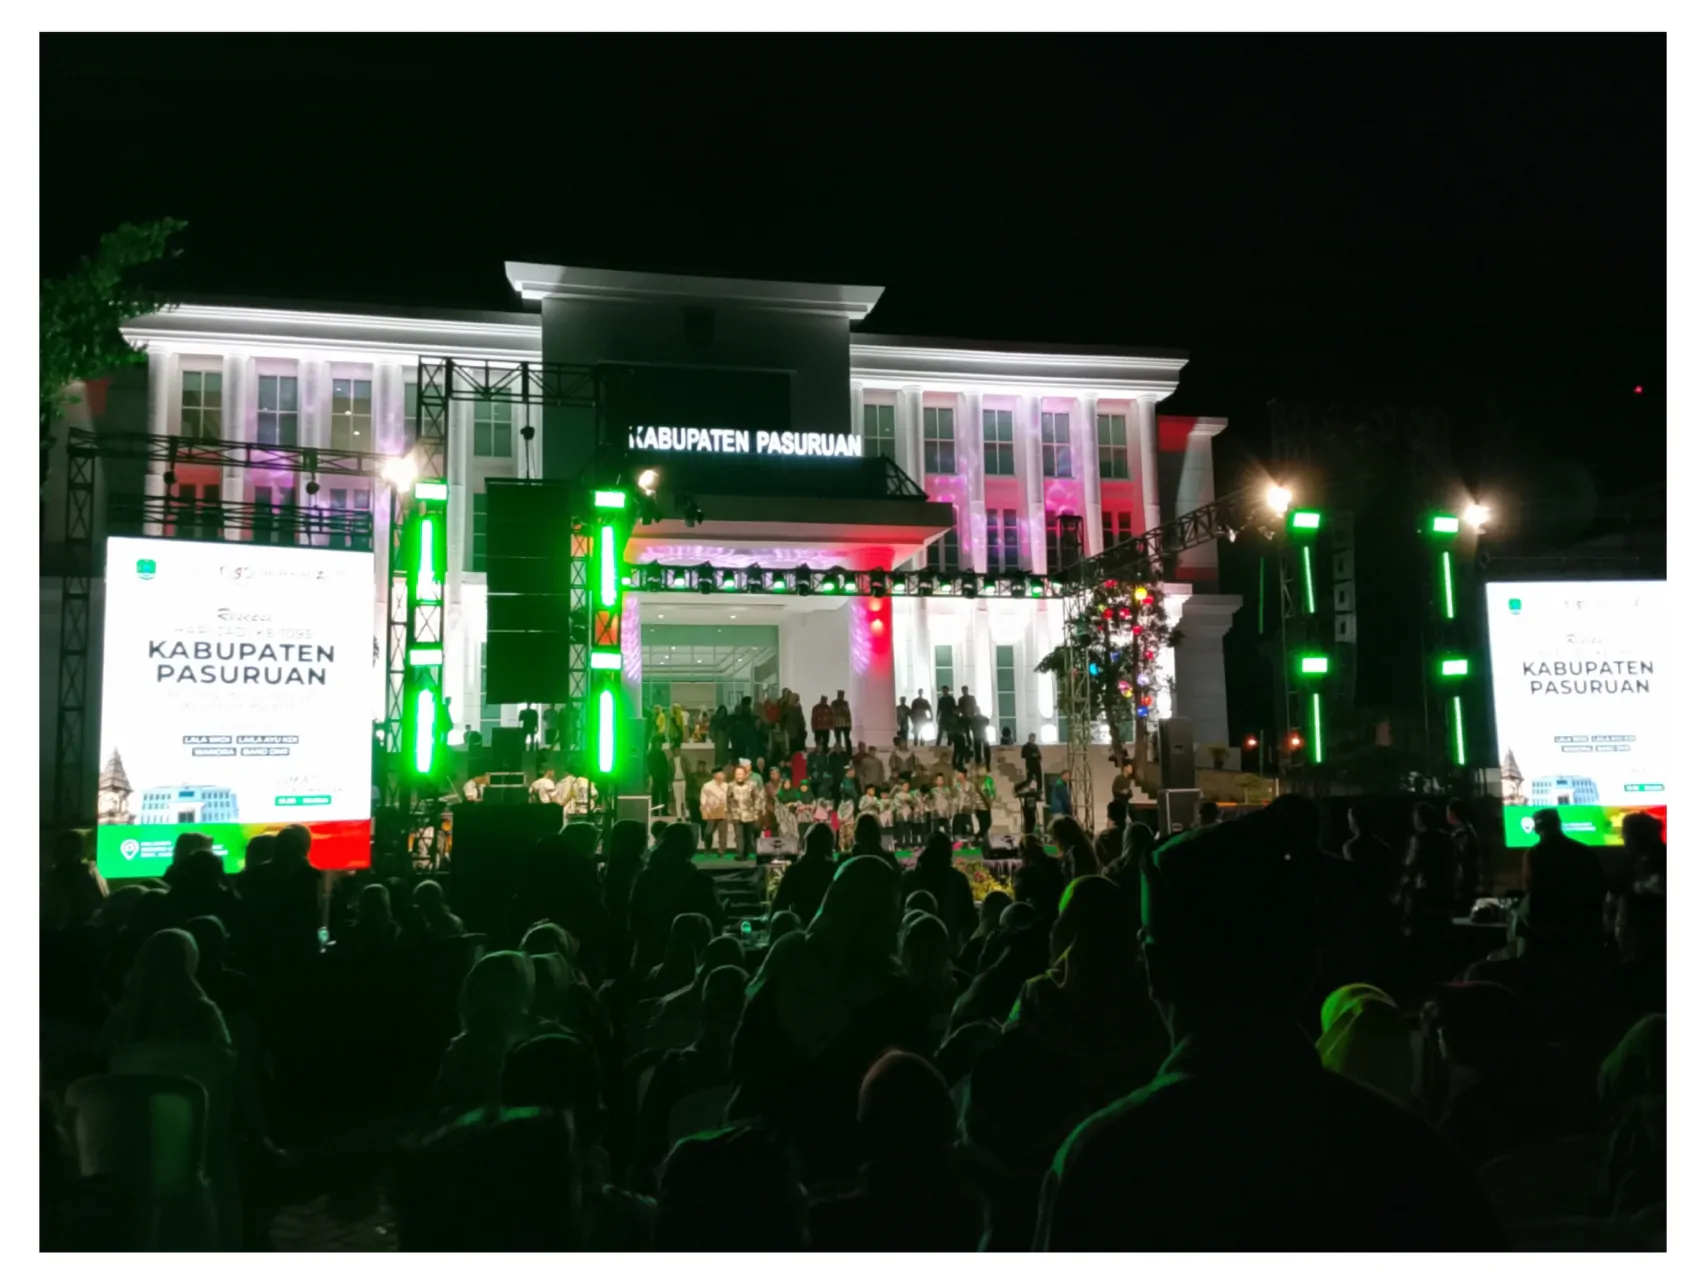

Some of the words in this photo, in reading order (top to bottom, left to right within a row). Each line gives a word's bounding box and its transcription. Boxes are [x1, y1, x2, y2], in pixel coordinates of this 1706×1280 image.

[629, 425, 749, 452] KABUPATEN
[756, 430, 862, 456] PASURUAN
[149, 640, 334, 662] KABUPATEN
[157, 664, 326, 685] PASURUAN
[1523, 661, 1653, 676] KABUPATEN
[1530, 679, 1650, 695] PASURUAN
